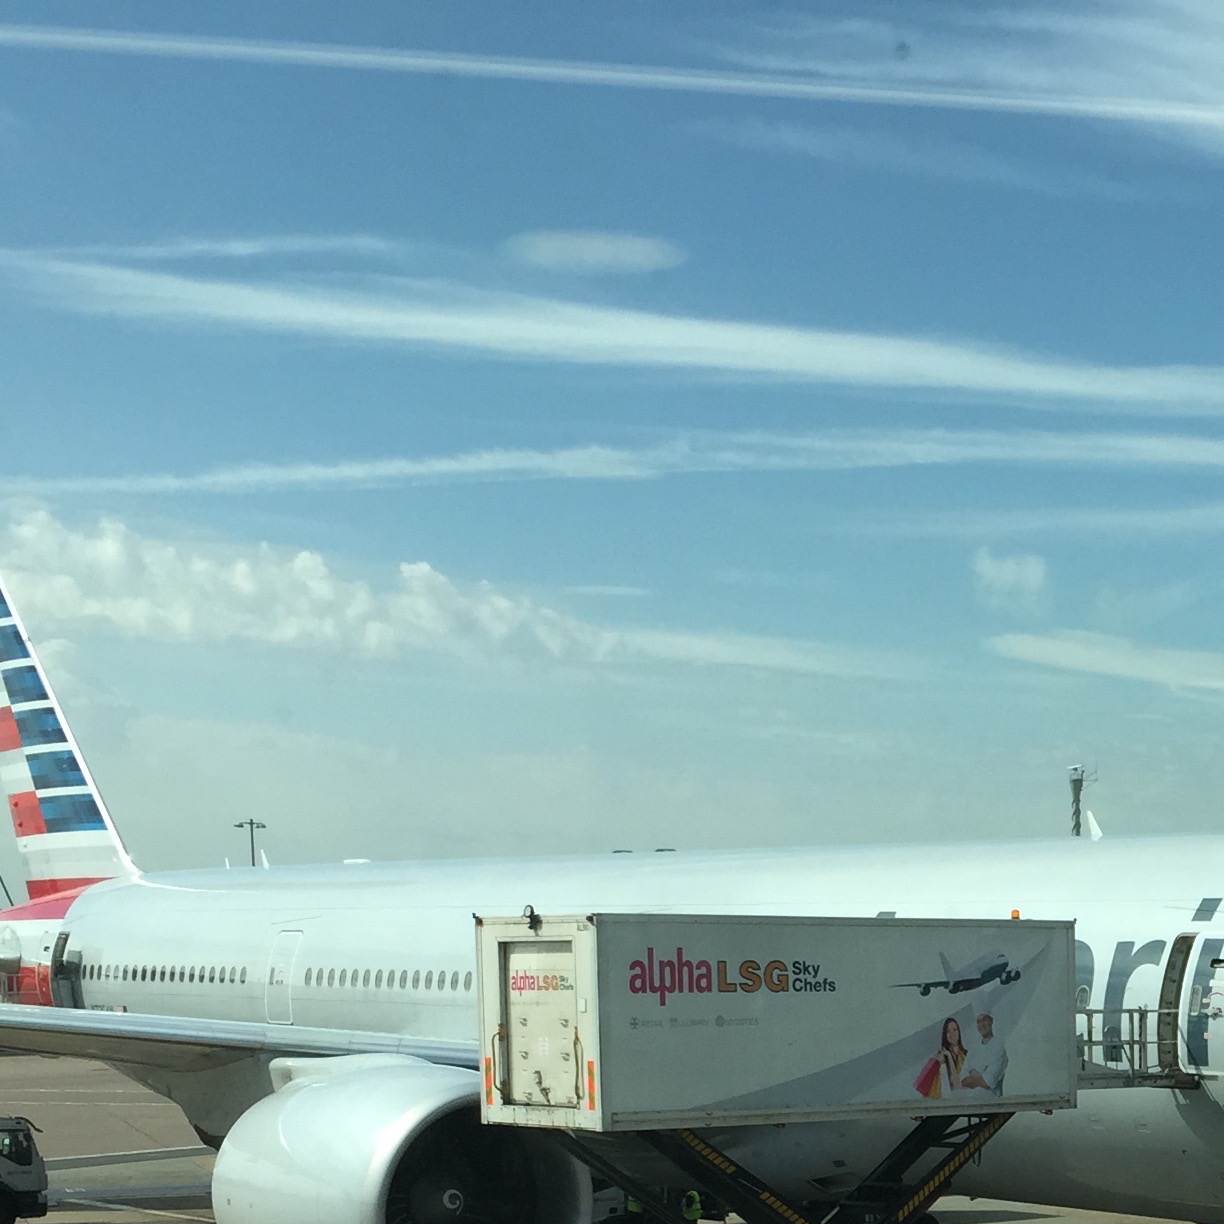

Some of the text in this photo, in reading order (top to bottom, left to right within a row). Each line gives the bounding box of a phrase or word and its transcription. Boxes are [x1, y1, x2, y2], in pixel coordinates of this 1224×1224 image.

[629, 947, 789, 1006] alpha LSG
[791, 960, 821, 978] Sky
[511, 969, 559, 996] alpha LSG
[791, 977, 837, 993] Chefs
